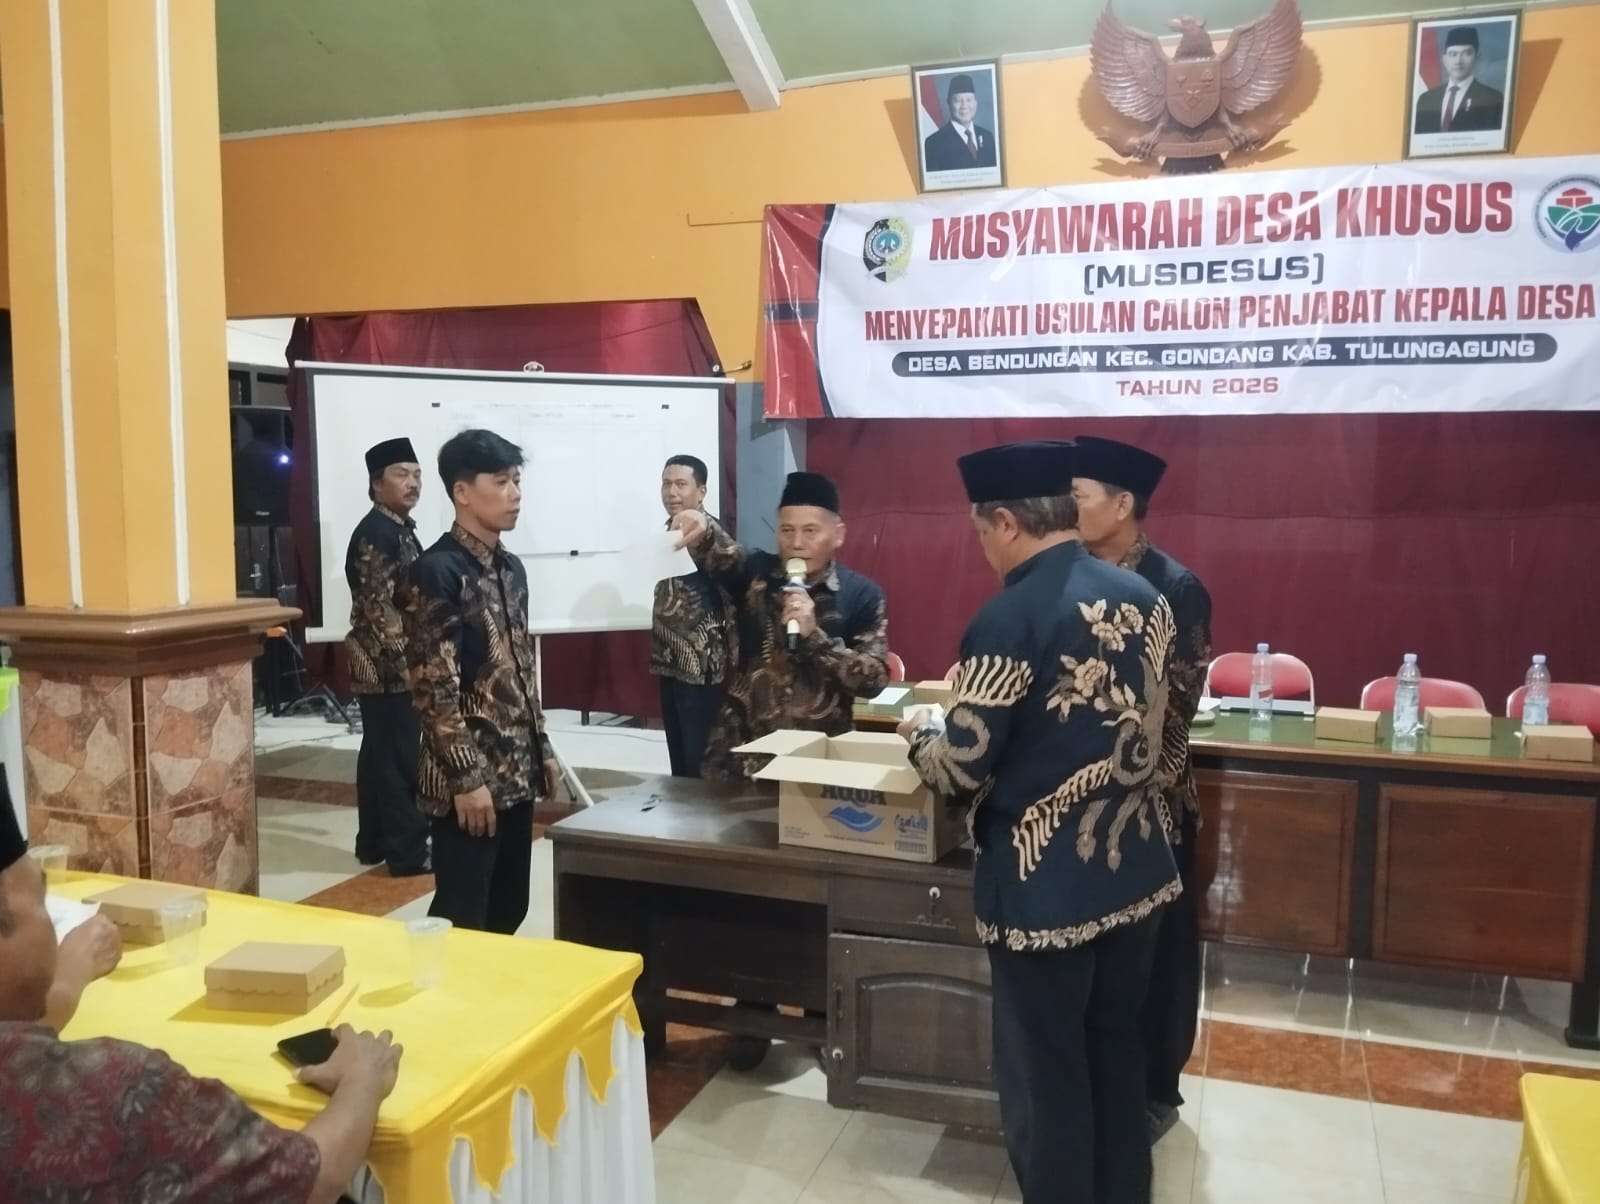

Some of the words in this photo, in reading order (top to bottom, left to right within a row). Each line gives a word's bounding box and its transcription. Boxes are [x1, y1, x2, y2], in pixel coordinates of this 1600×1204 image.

[928, 196, 1203, 261] MUSYAWARAH
[1215, 190, 1322, 247] DESA
[1335, 181, 1513, 239] KHUSUS
[865, 304, 1029, 341] MENYEPAKATI
[1035, 299, 1136, 334] USULAN
[1143, 296, 1231, 332] CALON
[1238, 289, 1386, 328] PENJABAT
[1394, 286, 1507, 324] KEPALA
[1516, 283, 1596, 321] DESA
[907, 354, 962, 373] DESA
[967, 350, 1098, 371] BENDUNGAN
[1105, 349, 1153, 367] KEC.
[1161, 345, 1274, 366] GONDANG
[1281, 343, 1337, 361] KAB.
[1345, 340, 1536, 360] TULUNGAGUNG
[1115, 378, 1202, 397] TAHUN
[1212, 376, 1279, 395] 2026
